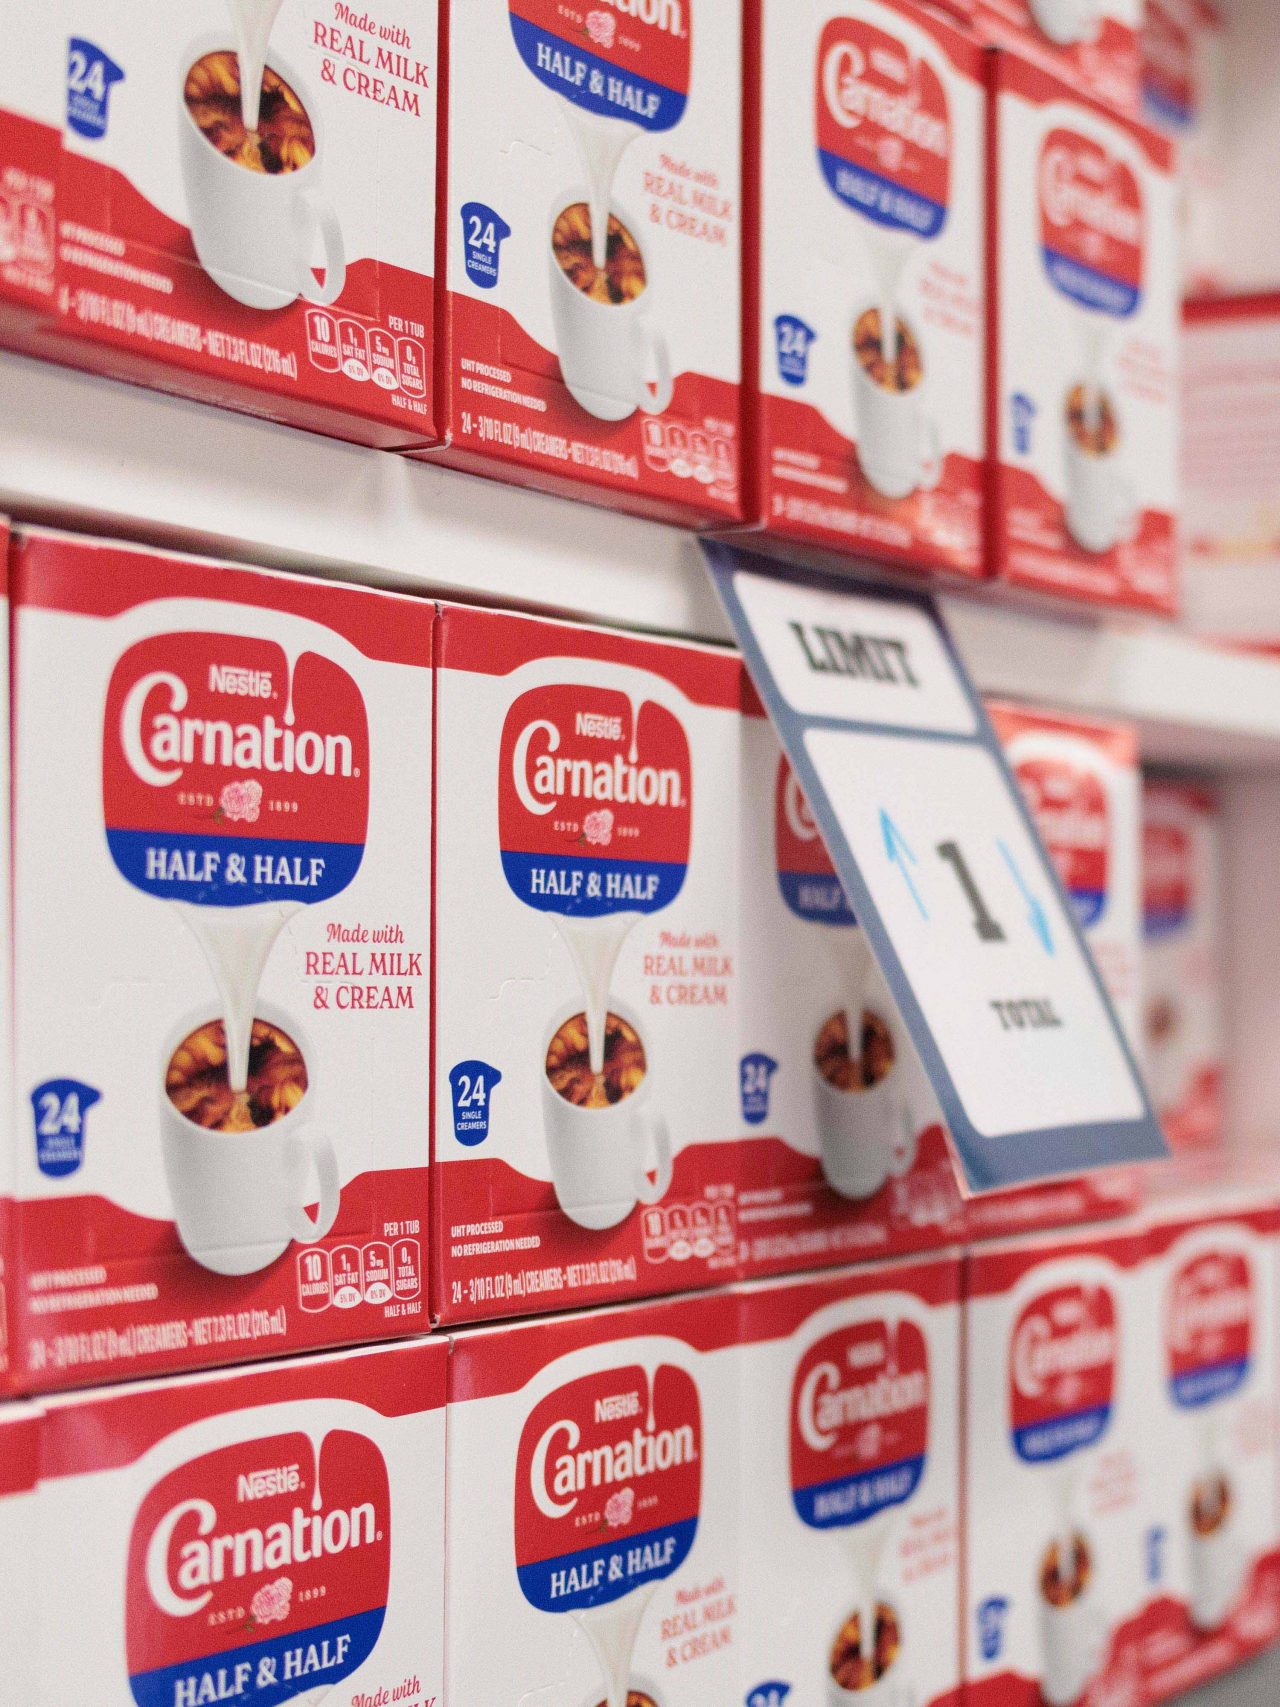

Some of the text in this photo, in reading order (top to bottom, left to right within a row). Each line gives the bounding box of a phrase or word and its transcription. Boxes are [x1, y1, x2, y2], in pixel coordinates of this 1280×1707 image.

[334, 2, 411, 49] Made with
[313, 20, 429, 88] REAL MILK
[68, 50, 104, 101] 24
[321, 58, 421, 118] & CREAM
[537, 41, 588, 87] HALF
[588, 67, 605, 98] &
[607, 76, 662, 119] HALF
[468, 215, 497, 254] 24
[467, 259, 498, 277] CREAMERS
[472, 250, 493, 265] SINGLE
[313, 315, 330, 342] 10
[388, 315, 403, 333] PER
[409, 321, 425, 338] TUB
[461, 357, 512, 384] UHT PROCESSED
[461, 376, 473, 391] NO
[391, 394, 406, 409] HALF
[413, 400, 428, 415] HALF
[461, 411, 472, 435] 24
[494, 420, 503, 443] FL
[502, 422, 513, 446] OZ
[788, 619, 920, 688] LIMIT
[209, 664, 273, 698] Nestlé
[120, 670, 353, 788] Carnation
[513, 719, 681, 816] Carnation
[269, 801, 298, 813] 1899
[553, 820, 580, 833] ESTD
[145, 847, 326, 887] HALF & HALF
[530, 867, 661, 901] HALF & HALF
[936, 840, 1007, 944] 1
[326, 923, 405, 944] Made with
[305, 951, 422, 976] REAL MILK
[313, 985, 414, 1010] & CREAM
[990, 999, 1064, 1030] TOTAL
[457, 1074, 487, 1108] 24
[38, 1092, 81, 1134] 24
[456, 1120, 487, 1131] CREAMERS
[461, 1110, 482, 1120] SINGLE
[384, 1219, 420, 1237] PER 1 TUB
[451, 1220, 504, 1238] UHT PROCESSED
[451, 1235, 541, 1258] NO REFRIGERATION NEEDED
[305, 1254, 322, 1281] 10
[334, 1271, 359, 1286] SAT FAT
[366, 1268, 389, 1283] SODIUM
[397, 1265, 416, 1278] TOTAL
[301, 1281, 329, 1297] CALORIES
[396, 1278, 419, 1291] SUGARS
[452, 1280, 462, 1304] 24
[469, 1276, 485, 1305] 3/10
[485, 1276, 495, 1300] FL
[495, 1274, 505, 1298] OZ
[505, 1271, 513, 1299] (9
[513, 1269, 526, 1297] mL)
[526, 1266, 564, 1294] CREAMERS
[384, 1304, 400, 1318] HALF
[406, 1301, 422, 1315] HALF
[136, 1319, 188, 1355] CREAMERS
[193, 1316, 212, 1346] NET
[237, 1311, 252, 1339] OZ
[531, 1419, 694, 1519] Carnation
[146, 1499, 376, 1618] Carnation
[550, 1536, 677, 1600] HALF & HALF
[298, 1585, 327, 1603] 1899
[173, 1634, 352, 1707] HALF & HALF
[392, 1675, 421, 1702] with
